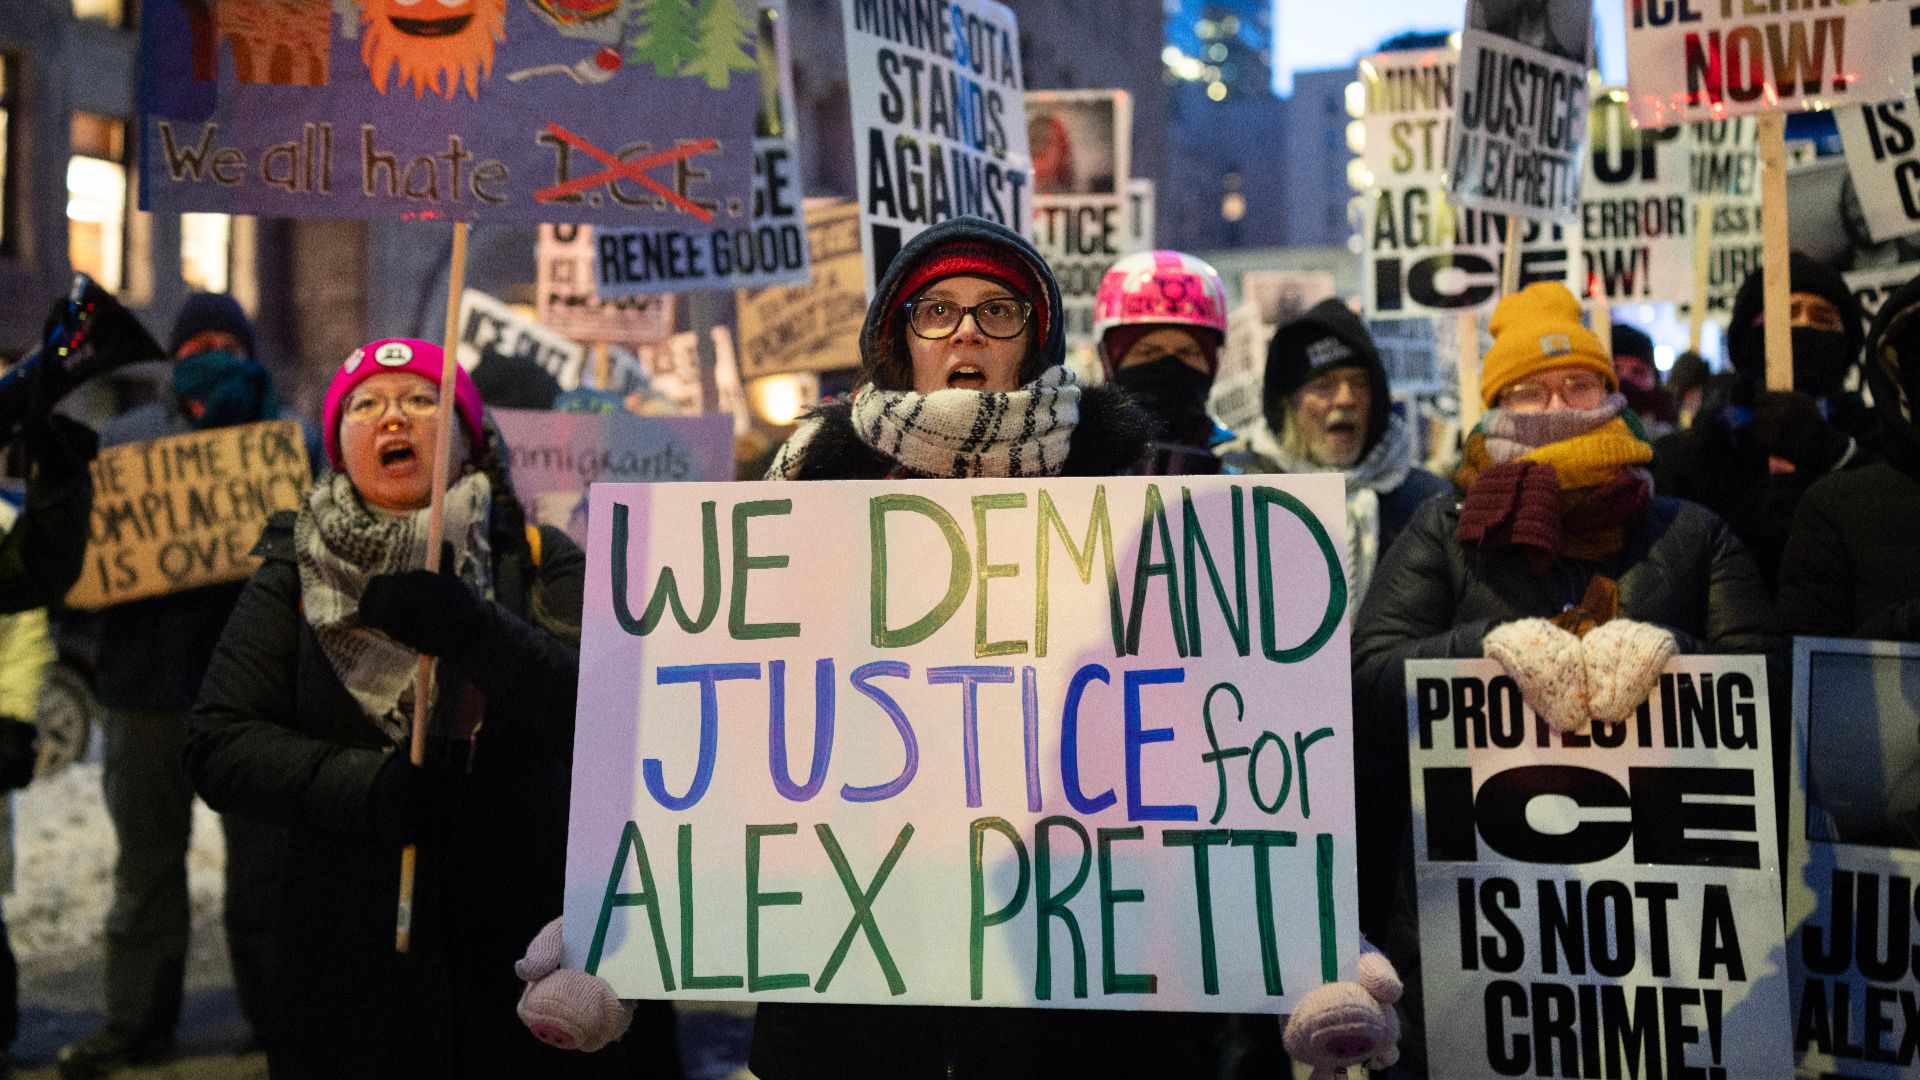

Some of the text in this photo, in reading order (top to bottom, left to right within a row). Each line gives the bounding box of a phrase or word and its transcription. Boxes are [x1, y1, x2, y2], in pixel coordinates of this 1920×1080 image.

[877, 48, 1007, 160] STANDS
[1463, 48, 1584, 151] JUSTICE
[1684, 17, 1847, 106] NOW!
[158, 121, 246, 187] We
[260, 121, 333, 194] all
[361, 123, 509, 202] hate
[868, 127, 1027, 234] AGAINST
[599, 224, 802, 286] RENEE GOOD
[97, 549, 139, 593] IS
[611, 484, 1348, 664] WE DEMAND
[642, 657, 1335, 825] JUSTICE for
[1422, 765, 1761, 870] ICE
[584, 815, 1337, 1001] ALEX PRETTI
[1457, 877, 1747, 982] IS NOT A
[1484, 980, 1728, 1080] CRIME!
